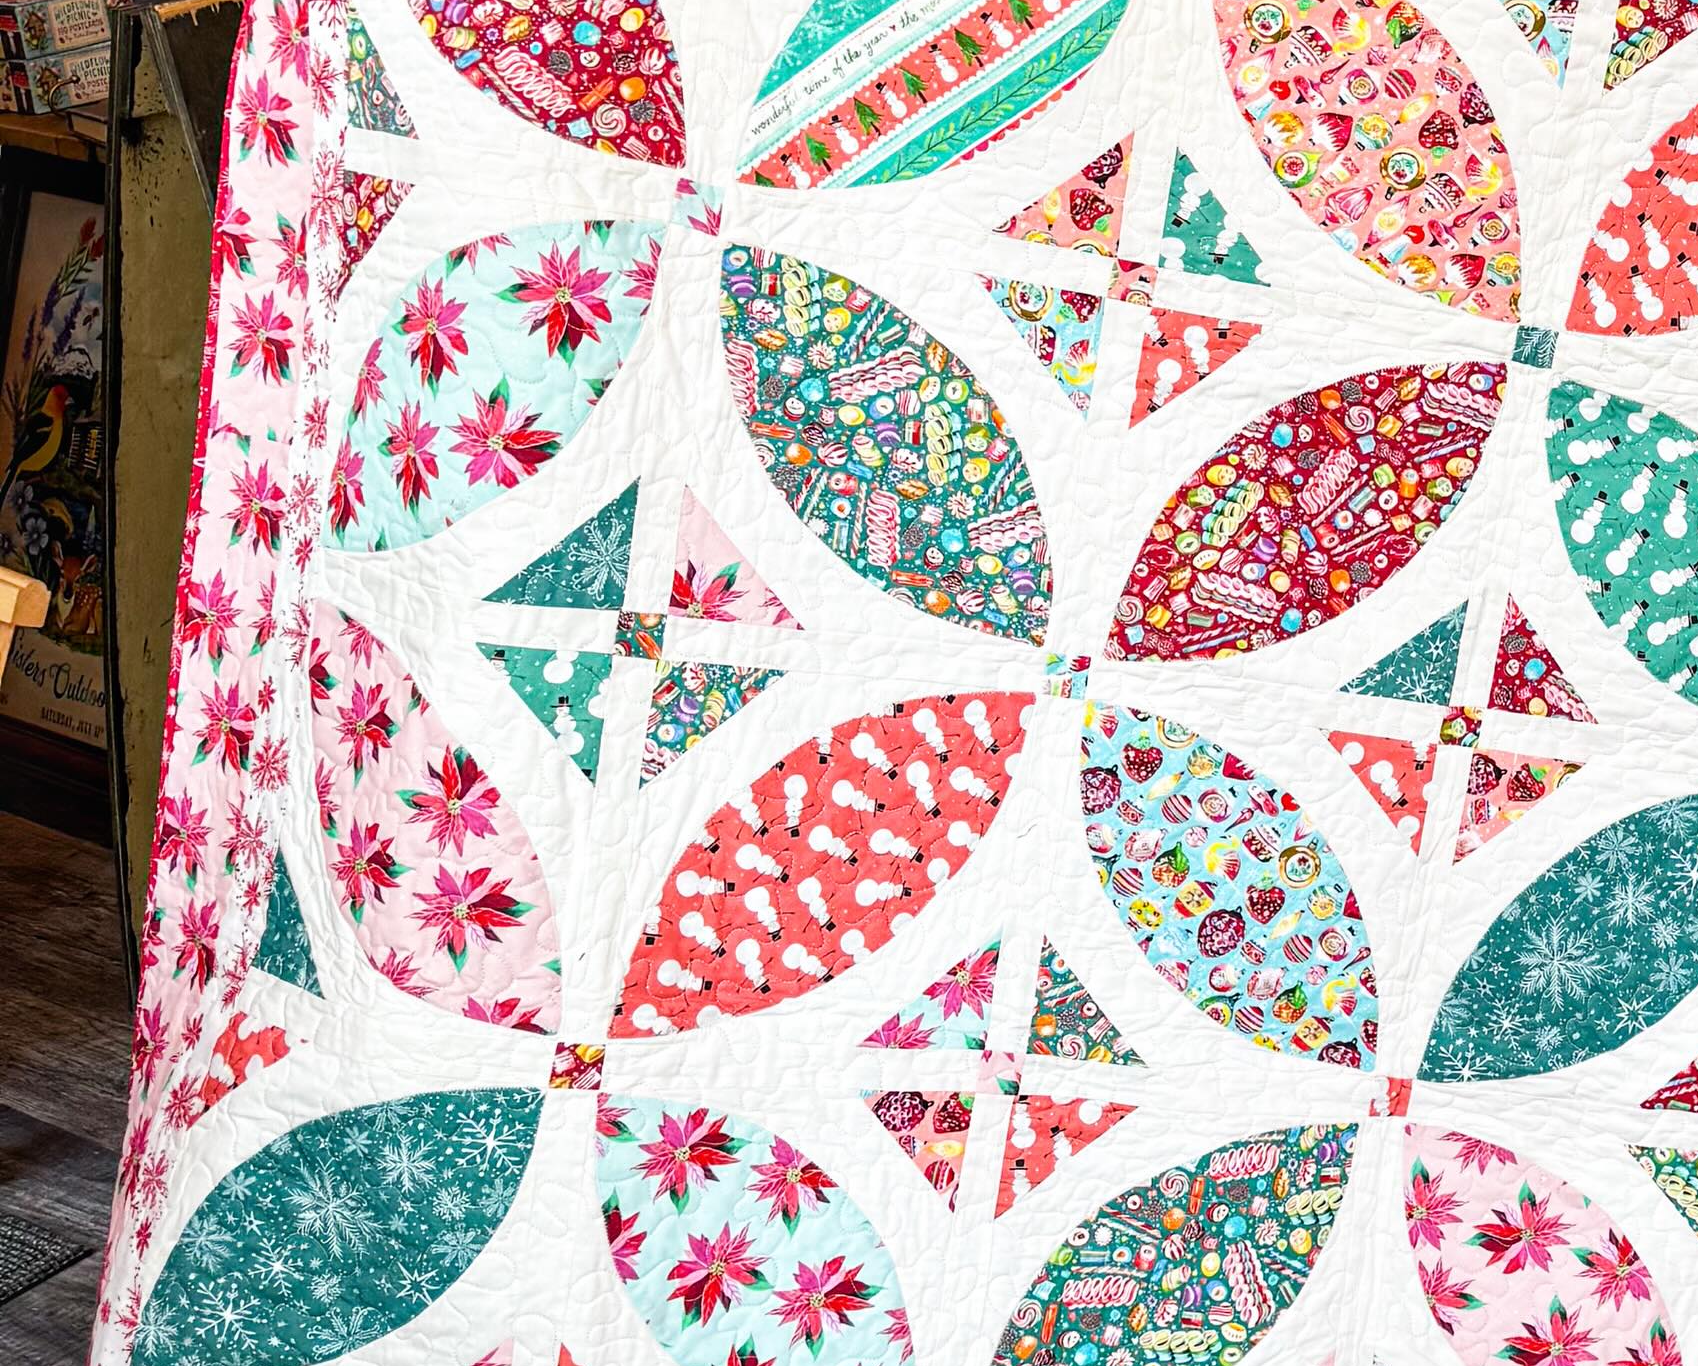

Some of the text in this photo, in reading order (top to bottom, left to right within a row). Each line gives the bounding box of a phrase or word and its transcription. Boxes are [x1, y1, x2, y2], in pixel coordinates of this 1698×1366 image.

[54, 0, 100, 22] WILDFLOWER
[66, 10, 92, 24] PICNIC
[900, 10, 919, 28] the
[70, 55, 111, 76] WILDFLOW
[751, 92, 801, 136] wonderful
[832, 56, 845, 79] of
[843, 47, 862, 65] the
[863, 30, 889, 57] year
[11, 643, 107, 708] isters Outdoo
